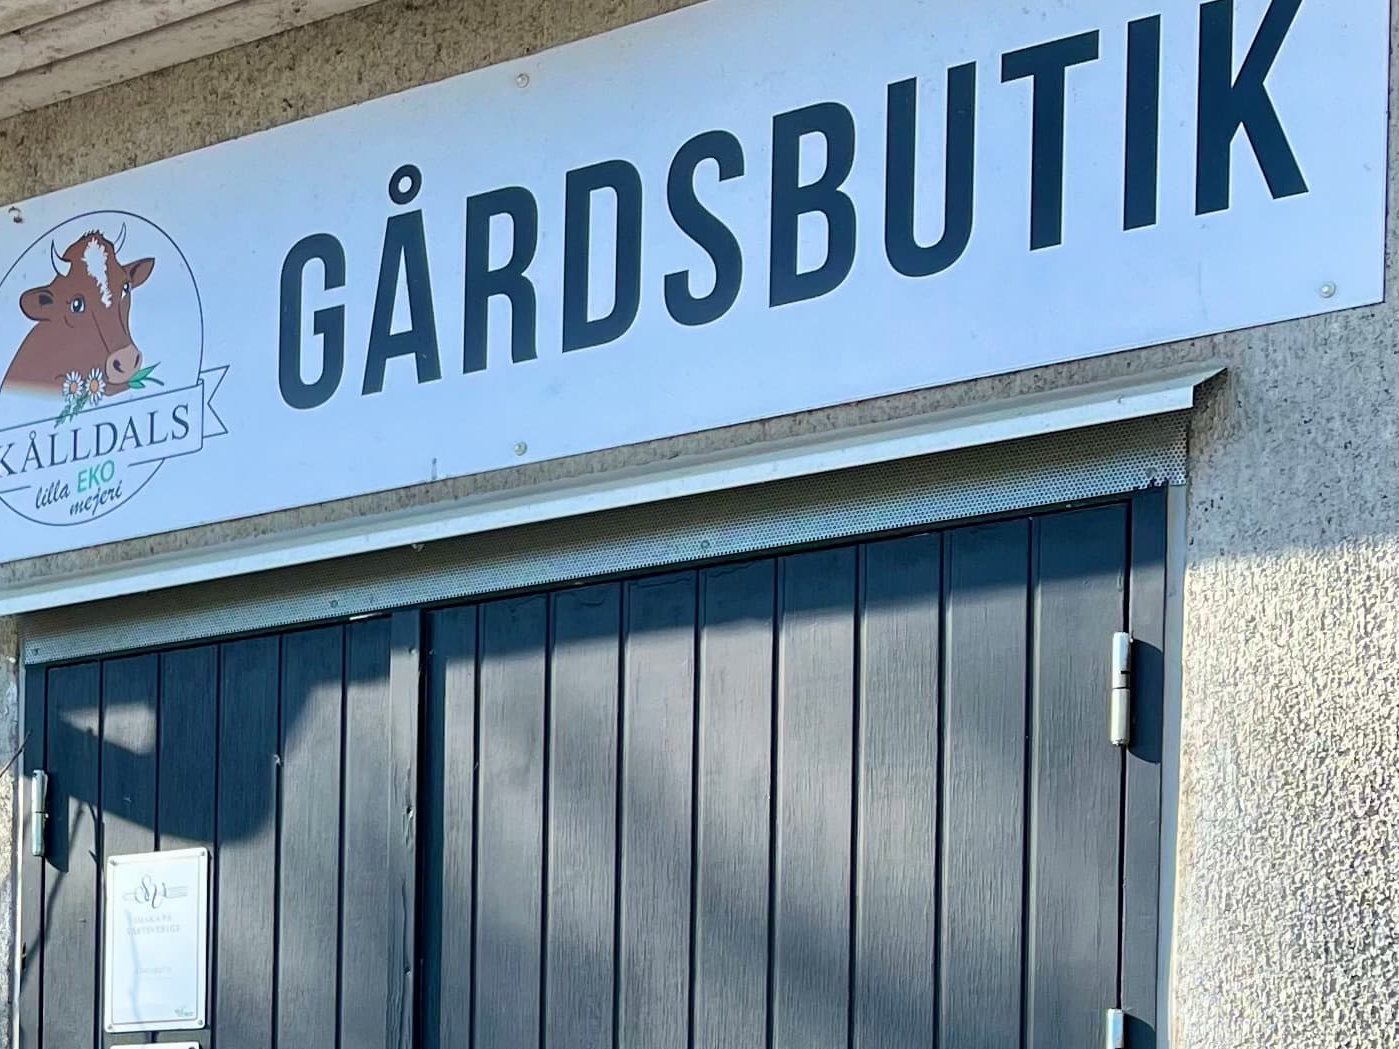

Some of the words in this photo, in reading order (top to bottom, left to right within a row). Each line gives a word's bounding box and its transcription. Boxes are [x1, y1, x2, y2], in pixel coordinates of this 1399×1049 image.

[278, 0, 1309, 409] GÅRDSBUTIK
[35, 480, 71, 510] lilla
[77, 460, 115, 493] EKO
[69, 479, 123, 517] mejeri
